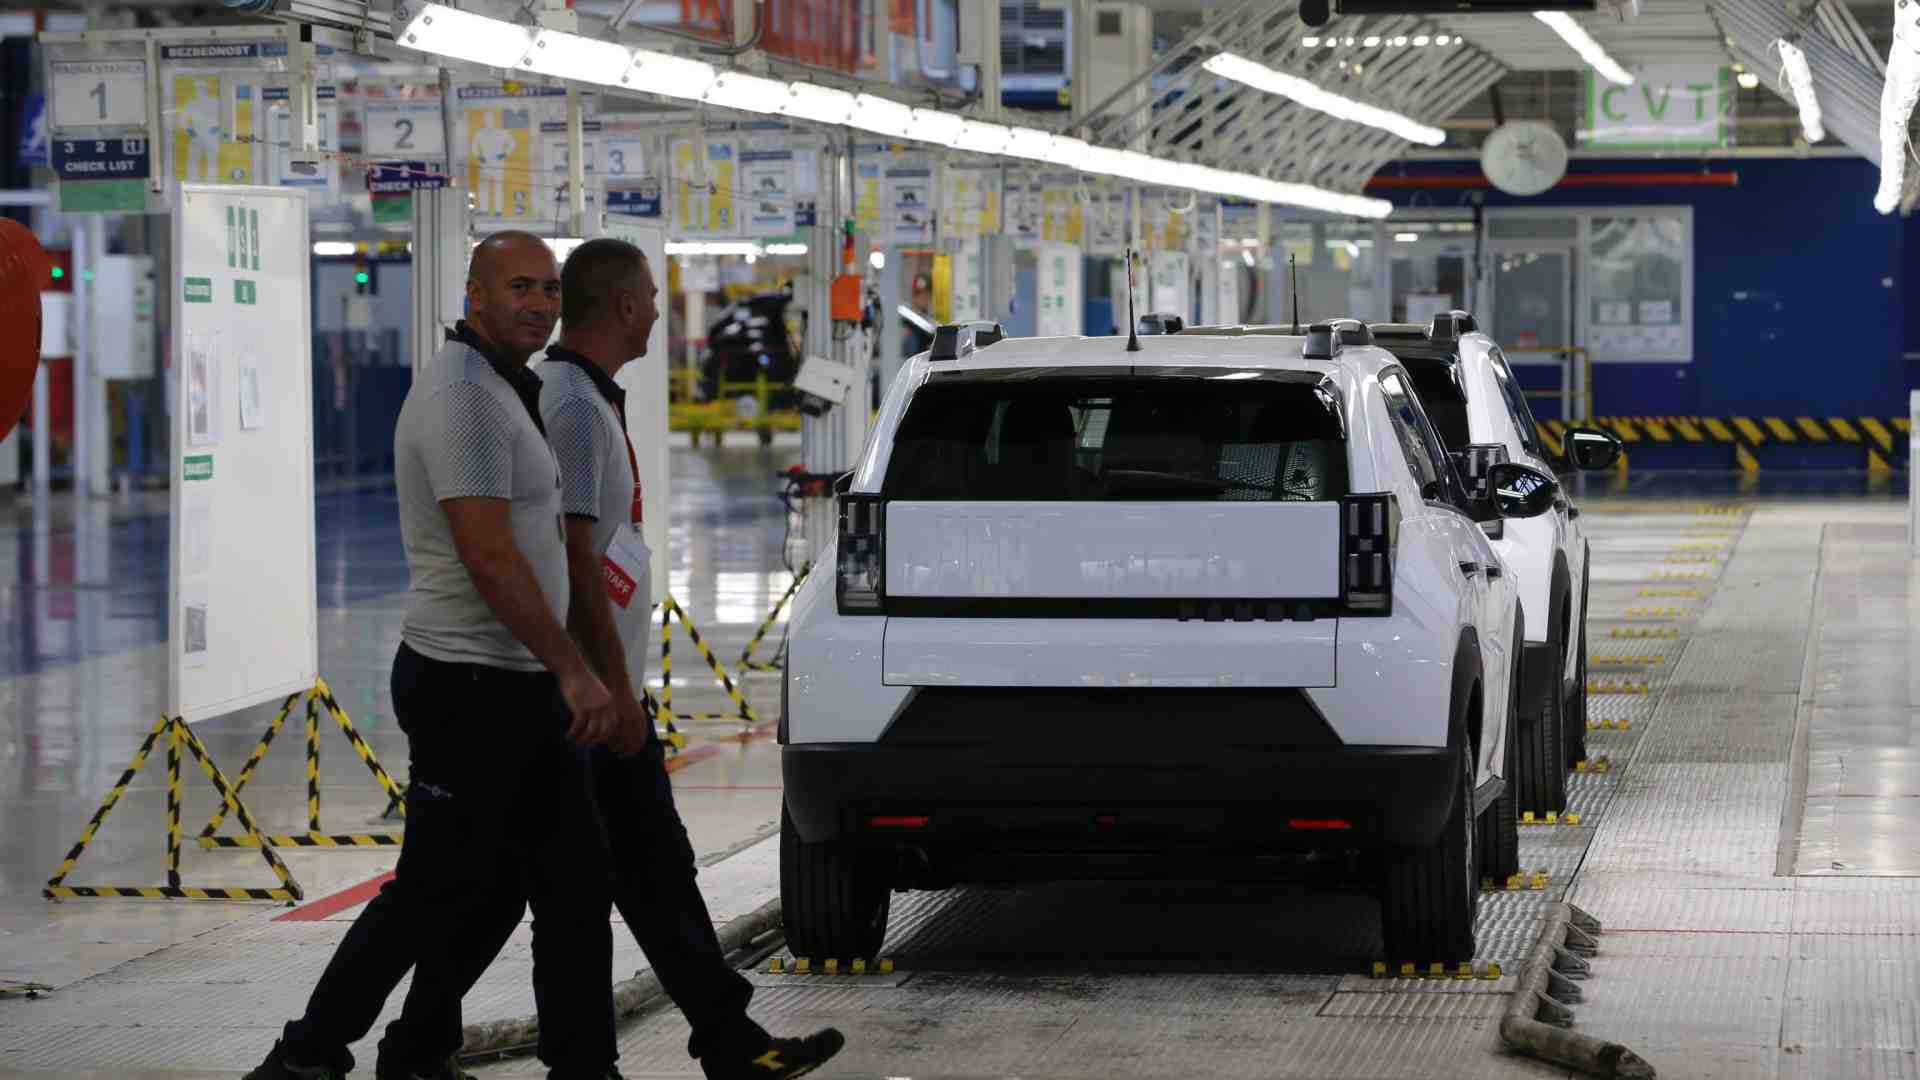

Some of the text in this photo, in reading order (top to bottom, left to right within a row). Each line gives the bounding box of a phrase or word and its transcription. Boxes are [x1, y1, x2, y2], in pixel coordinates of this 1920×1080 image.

[89, 81, 107, 120] 1
[1602, 81, 1713, 121] CVT
[64, 141, 75, 153] 3
[96, 141, 106, 153] 2
[394, 119, 414, 150] 2
[64, 160, 136, 172] CHECK LIST
[609, 149, 624, 175] 3
